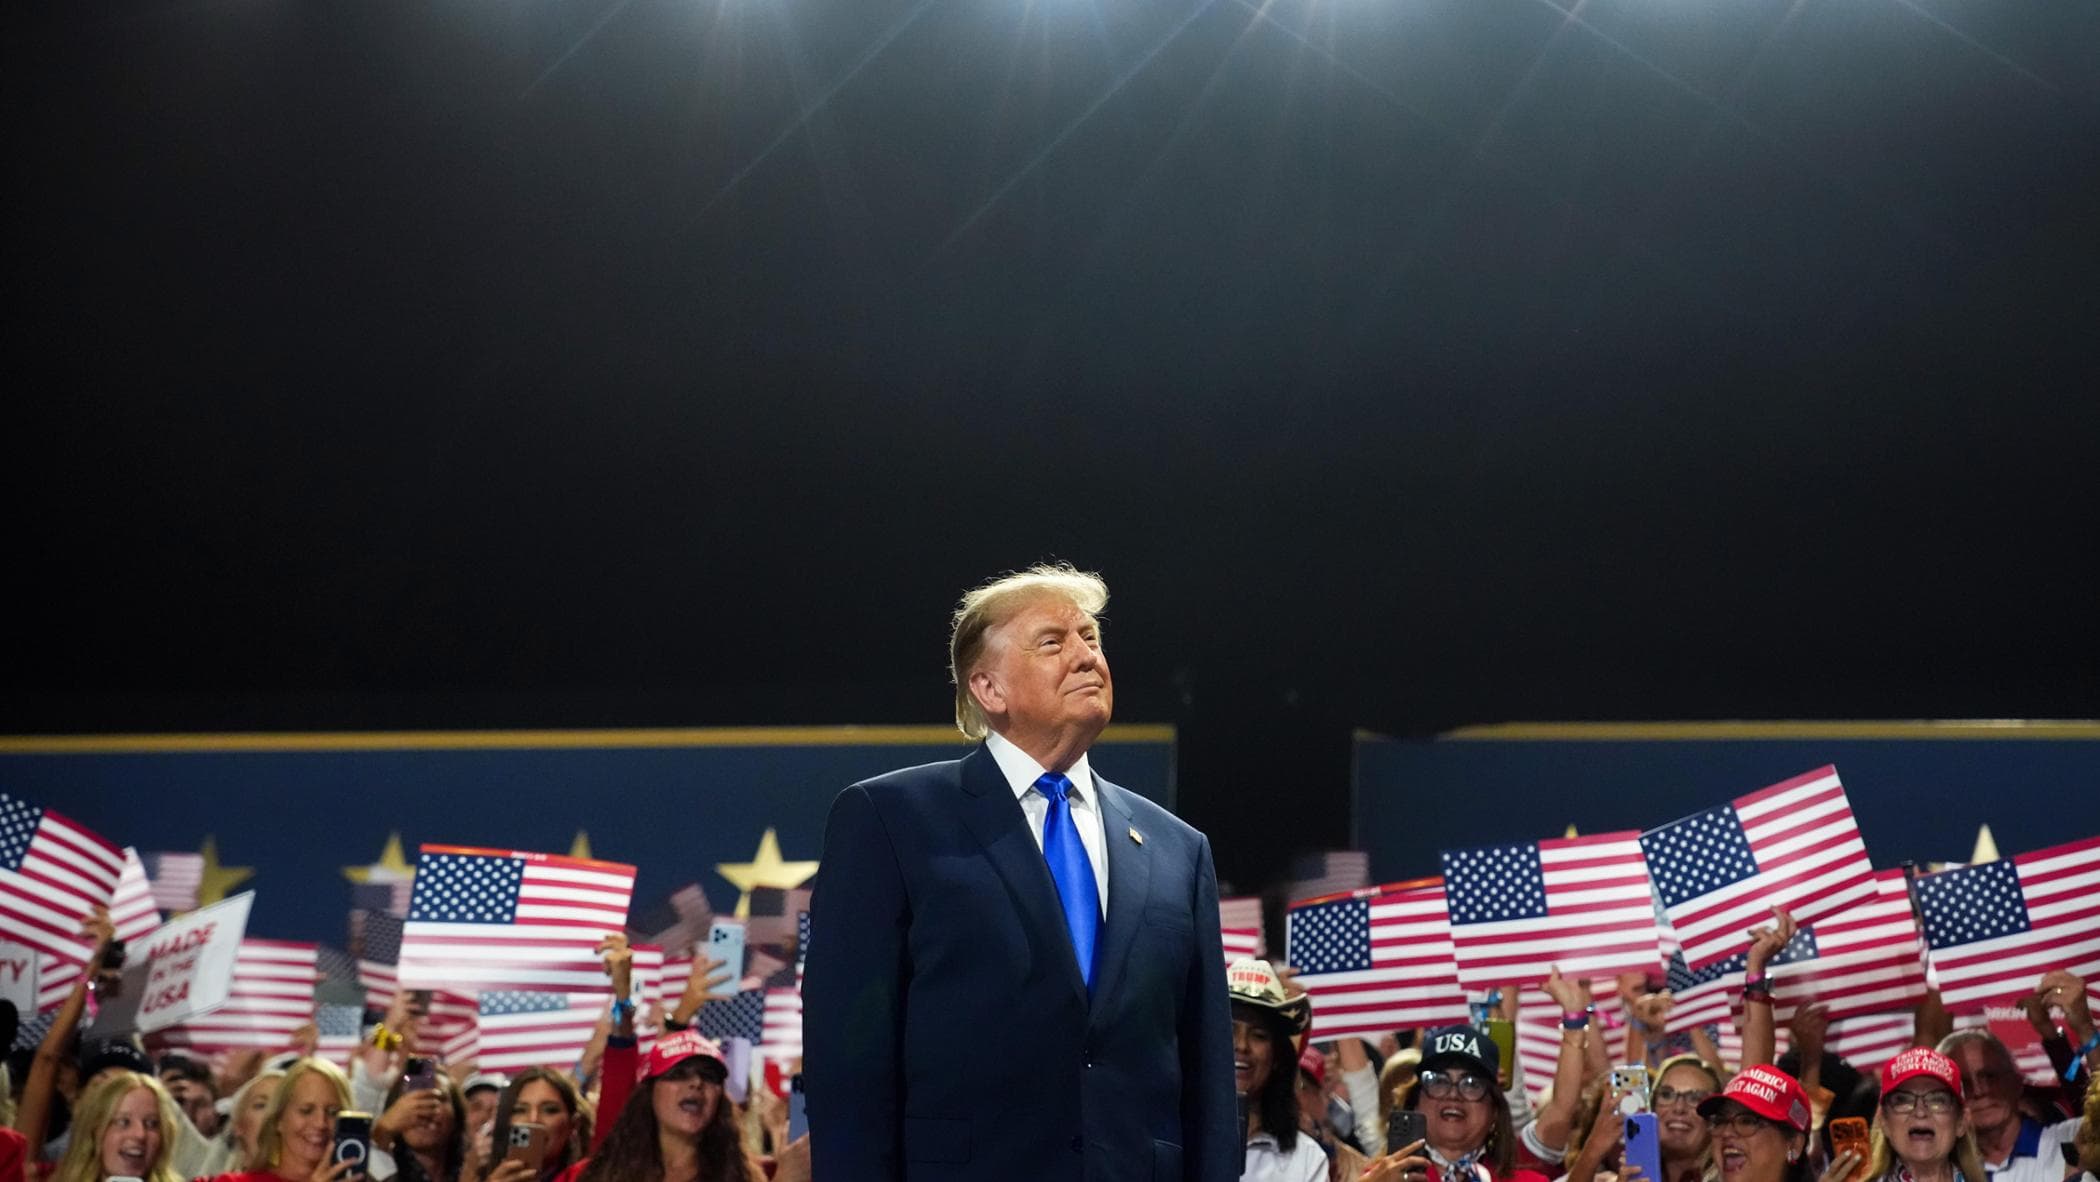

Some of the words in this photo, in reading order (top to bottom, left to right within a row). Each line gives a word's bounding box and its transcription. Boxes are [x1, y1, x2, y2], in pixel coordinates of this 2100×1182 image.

[148, 921, 218, 960] MADE
[1232, 971, 1271, 985] TRUMP
[143, 980, 190, 1014] USA
[1435, 1033, 1482, 1059] USA
[1896, 1048, 1930, 1063] TRUMP
[1742, 1081, 1777, 1104] AGAIN
[1748, 1068, 1788, 1095] AMERICA
